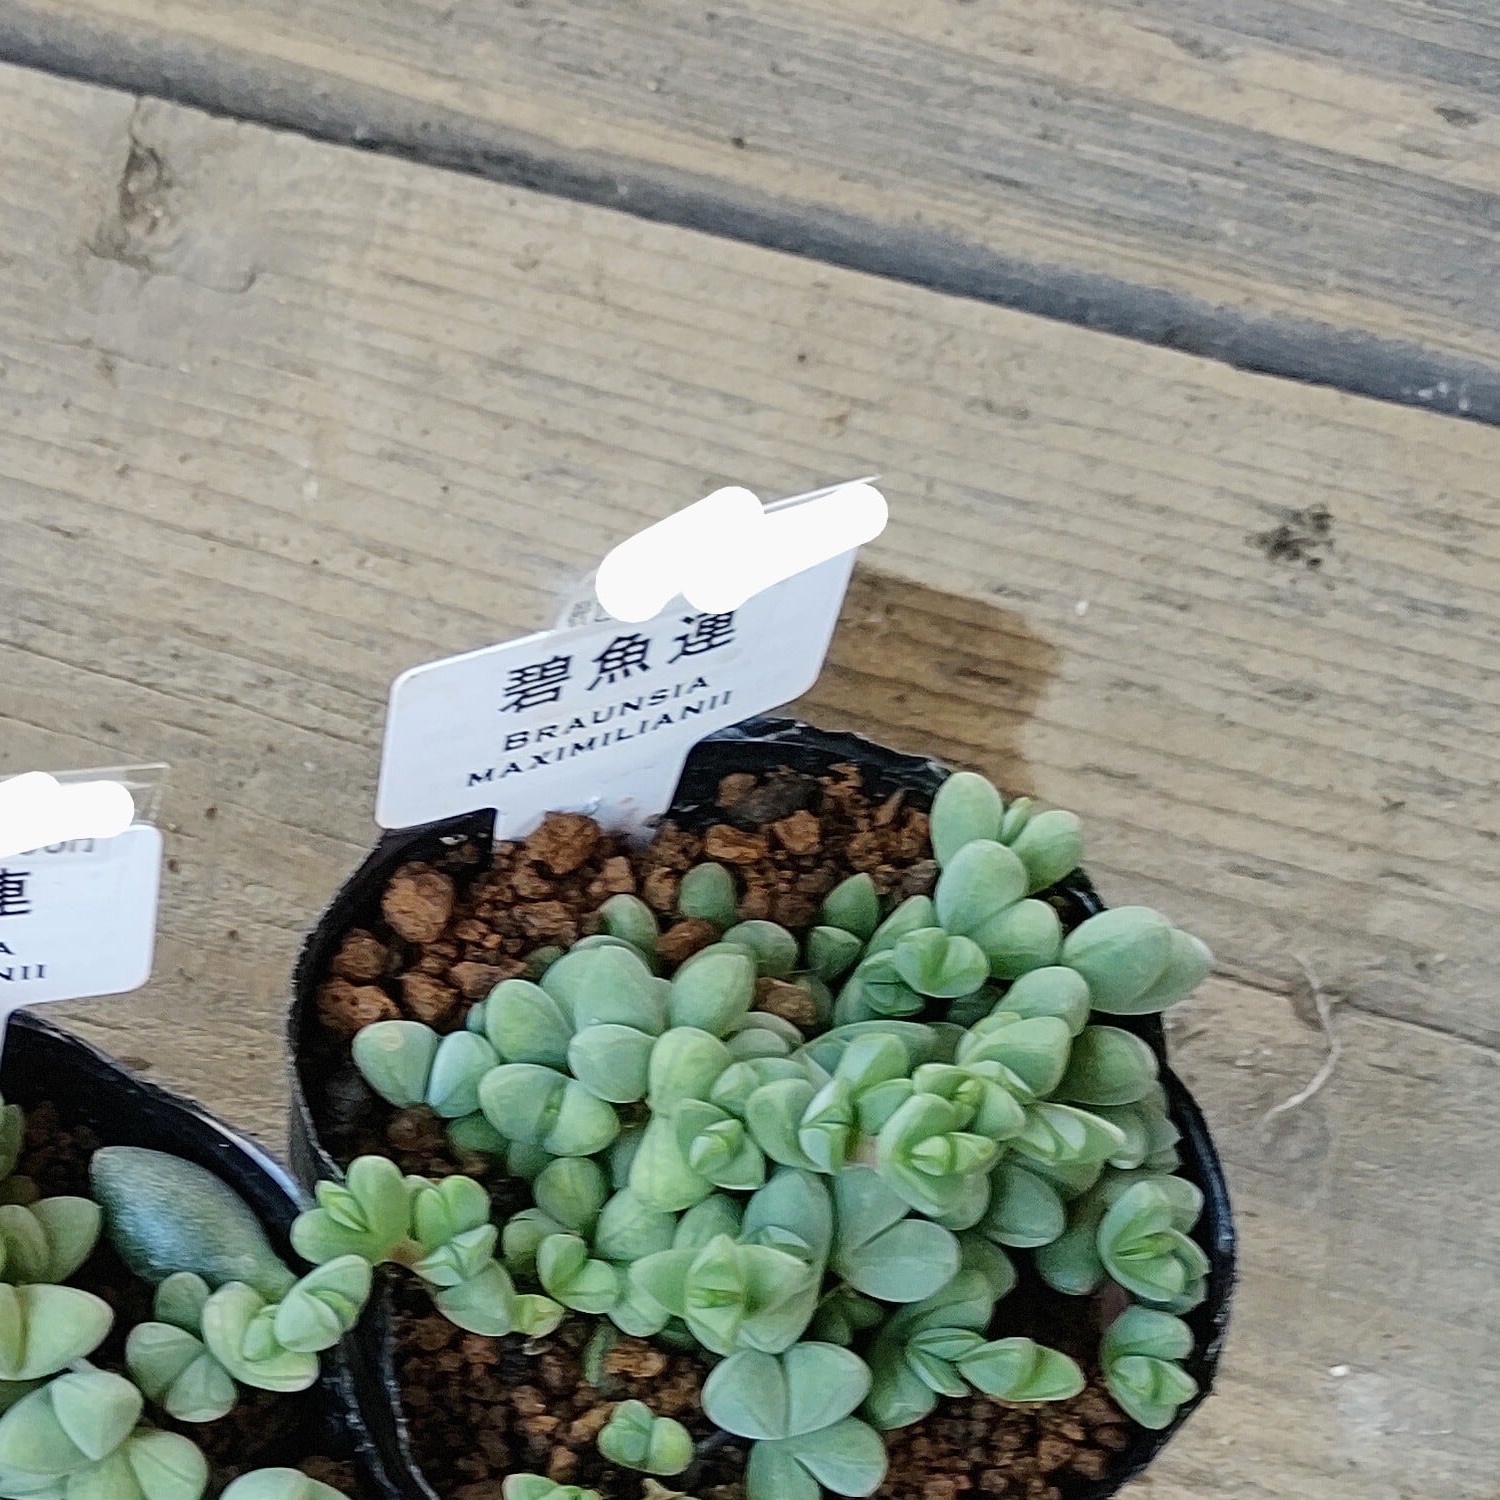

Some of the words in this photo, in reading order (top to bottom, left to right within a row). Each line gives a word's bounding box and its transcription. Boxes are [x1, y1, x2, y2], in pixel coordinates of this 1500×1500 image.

[499, 610, 737, 714] 碧魚連
[465, 690, 733, 788] MAXIMILIANII
[503, 676, 710, 752] BRAUNSIA
